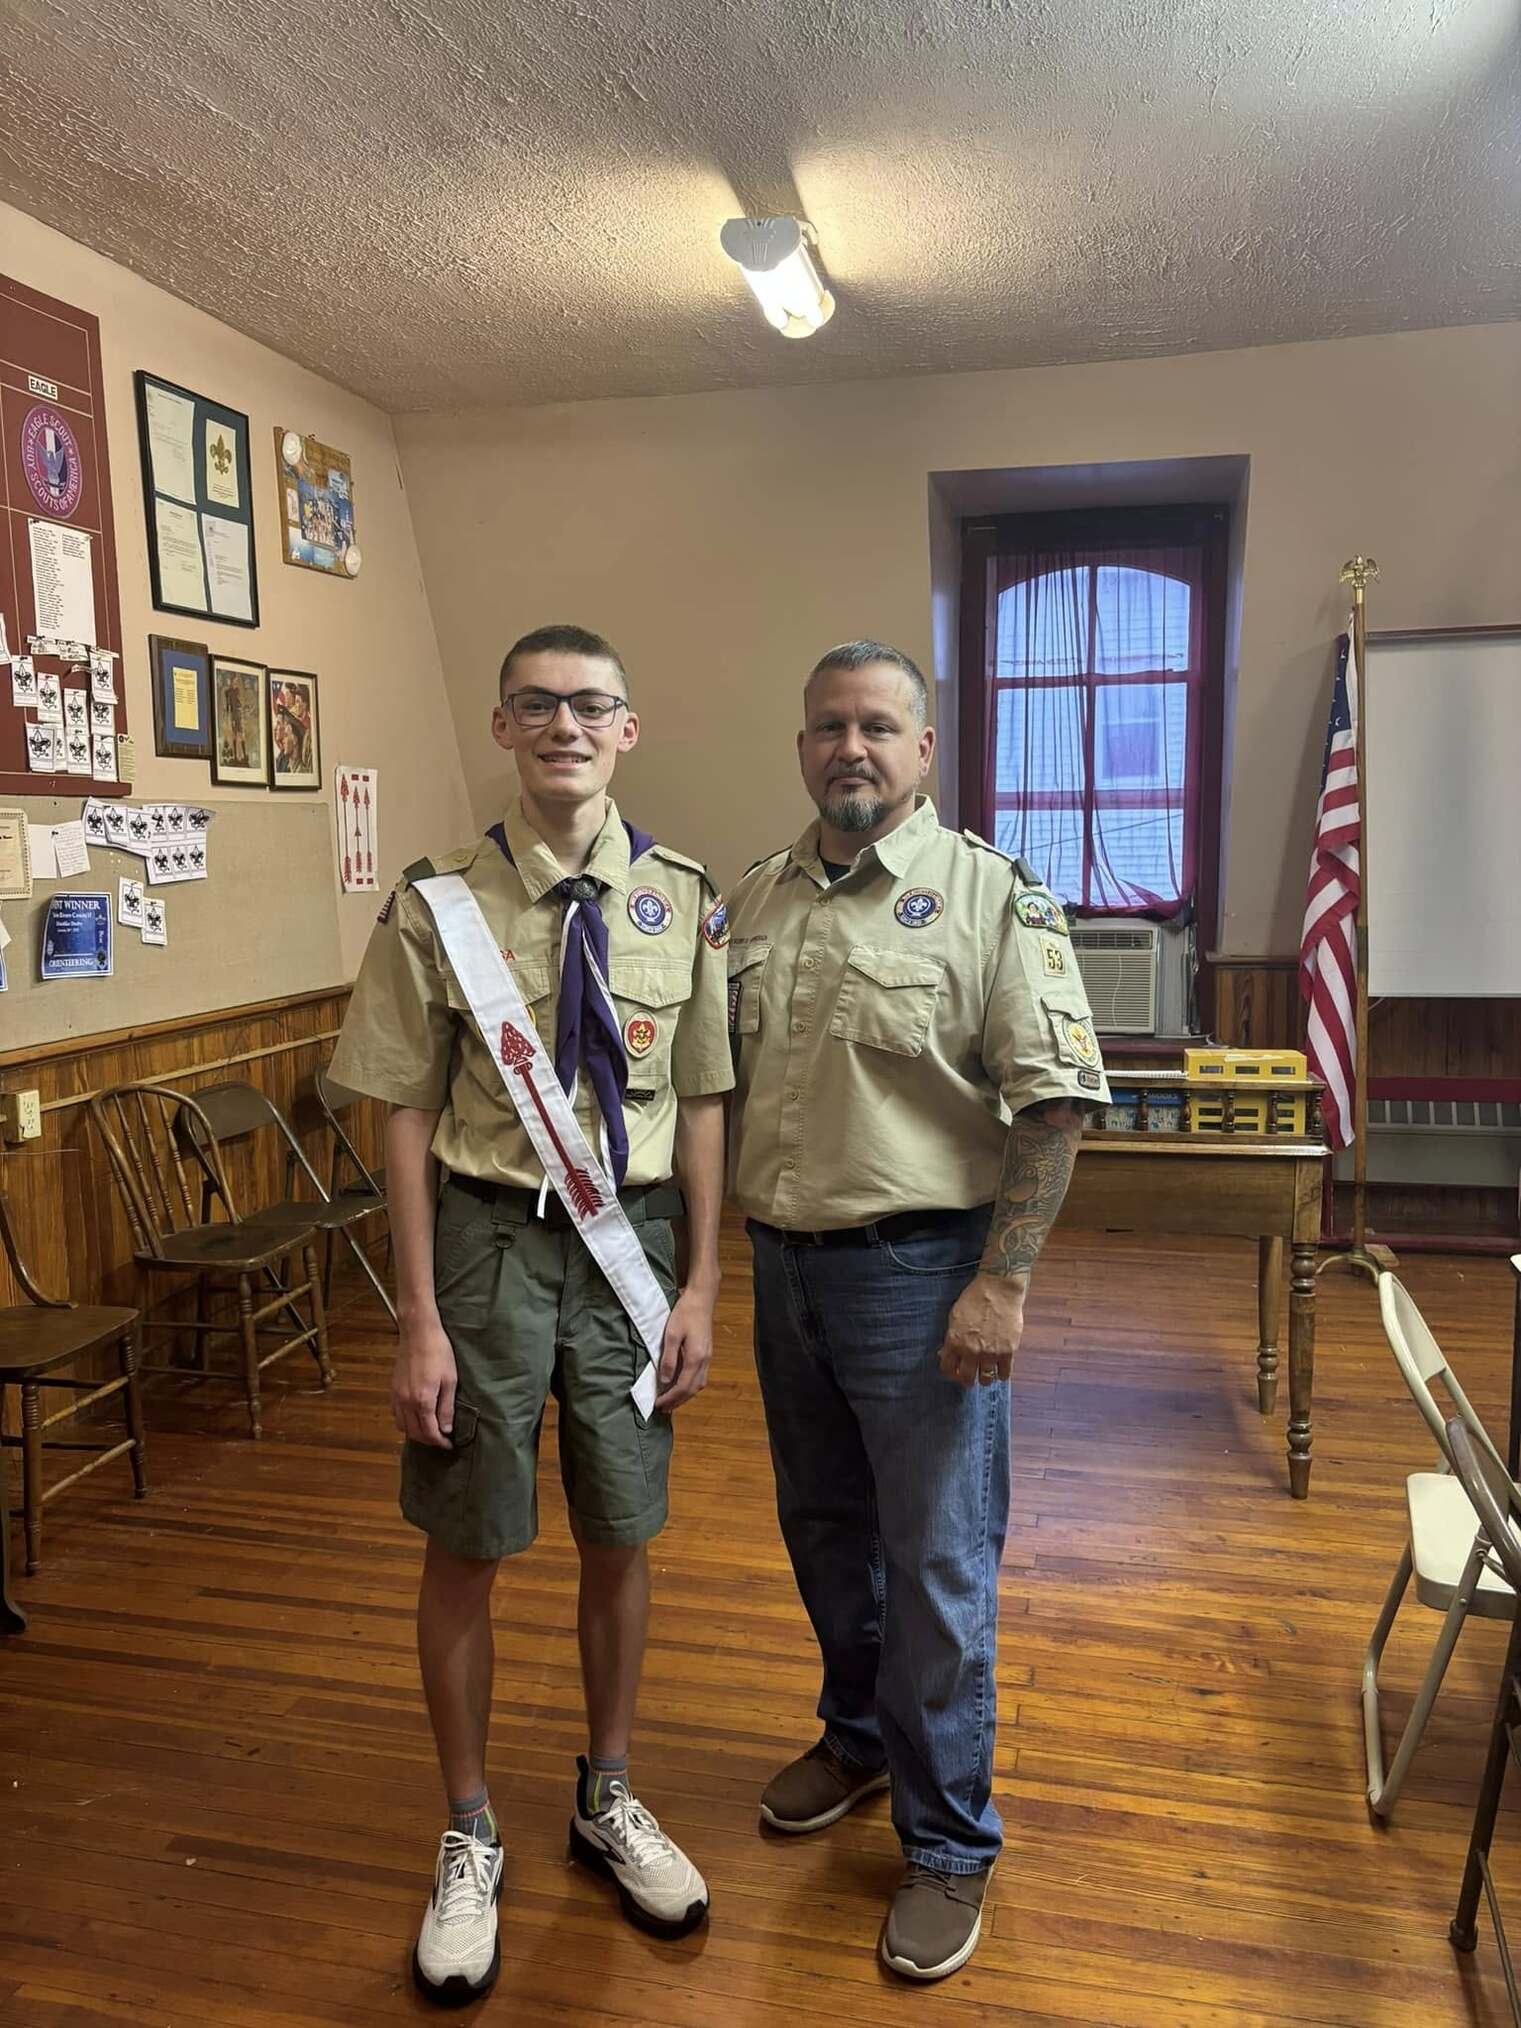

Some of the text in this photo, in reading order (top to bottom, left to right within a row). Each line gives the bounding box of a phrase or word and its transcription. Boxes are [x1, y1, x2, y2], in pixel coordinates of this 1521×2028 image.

[30, 378, 57, 397] EAGLE
[29, 412, 73, 448] EAGLE SCOUT
[31, 471, 60, 511] SCOUTS
[66, 457, 80, 505] AMERICA
[64, 900, 101, 910] WINNER
[1047, 948, 1064, 971] 53
